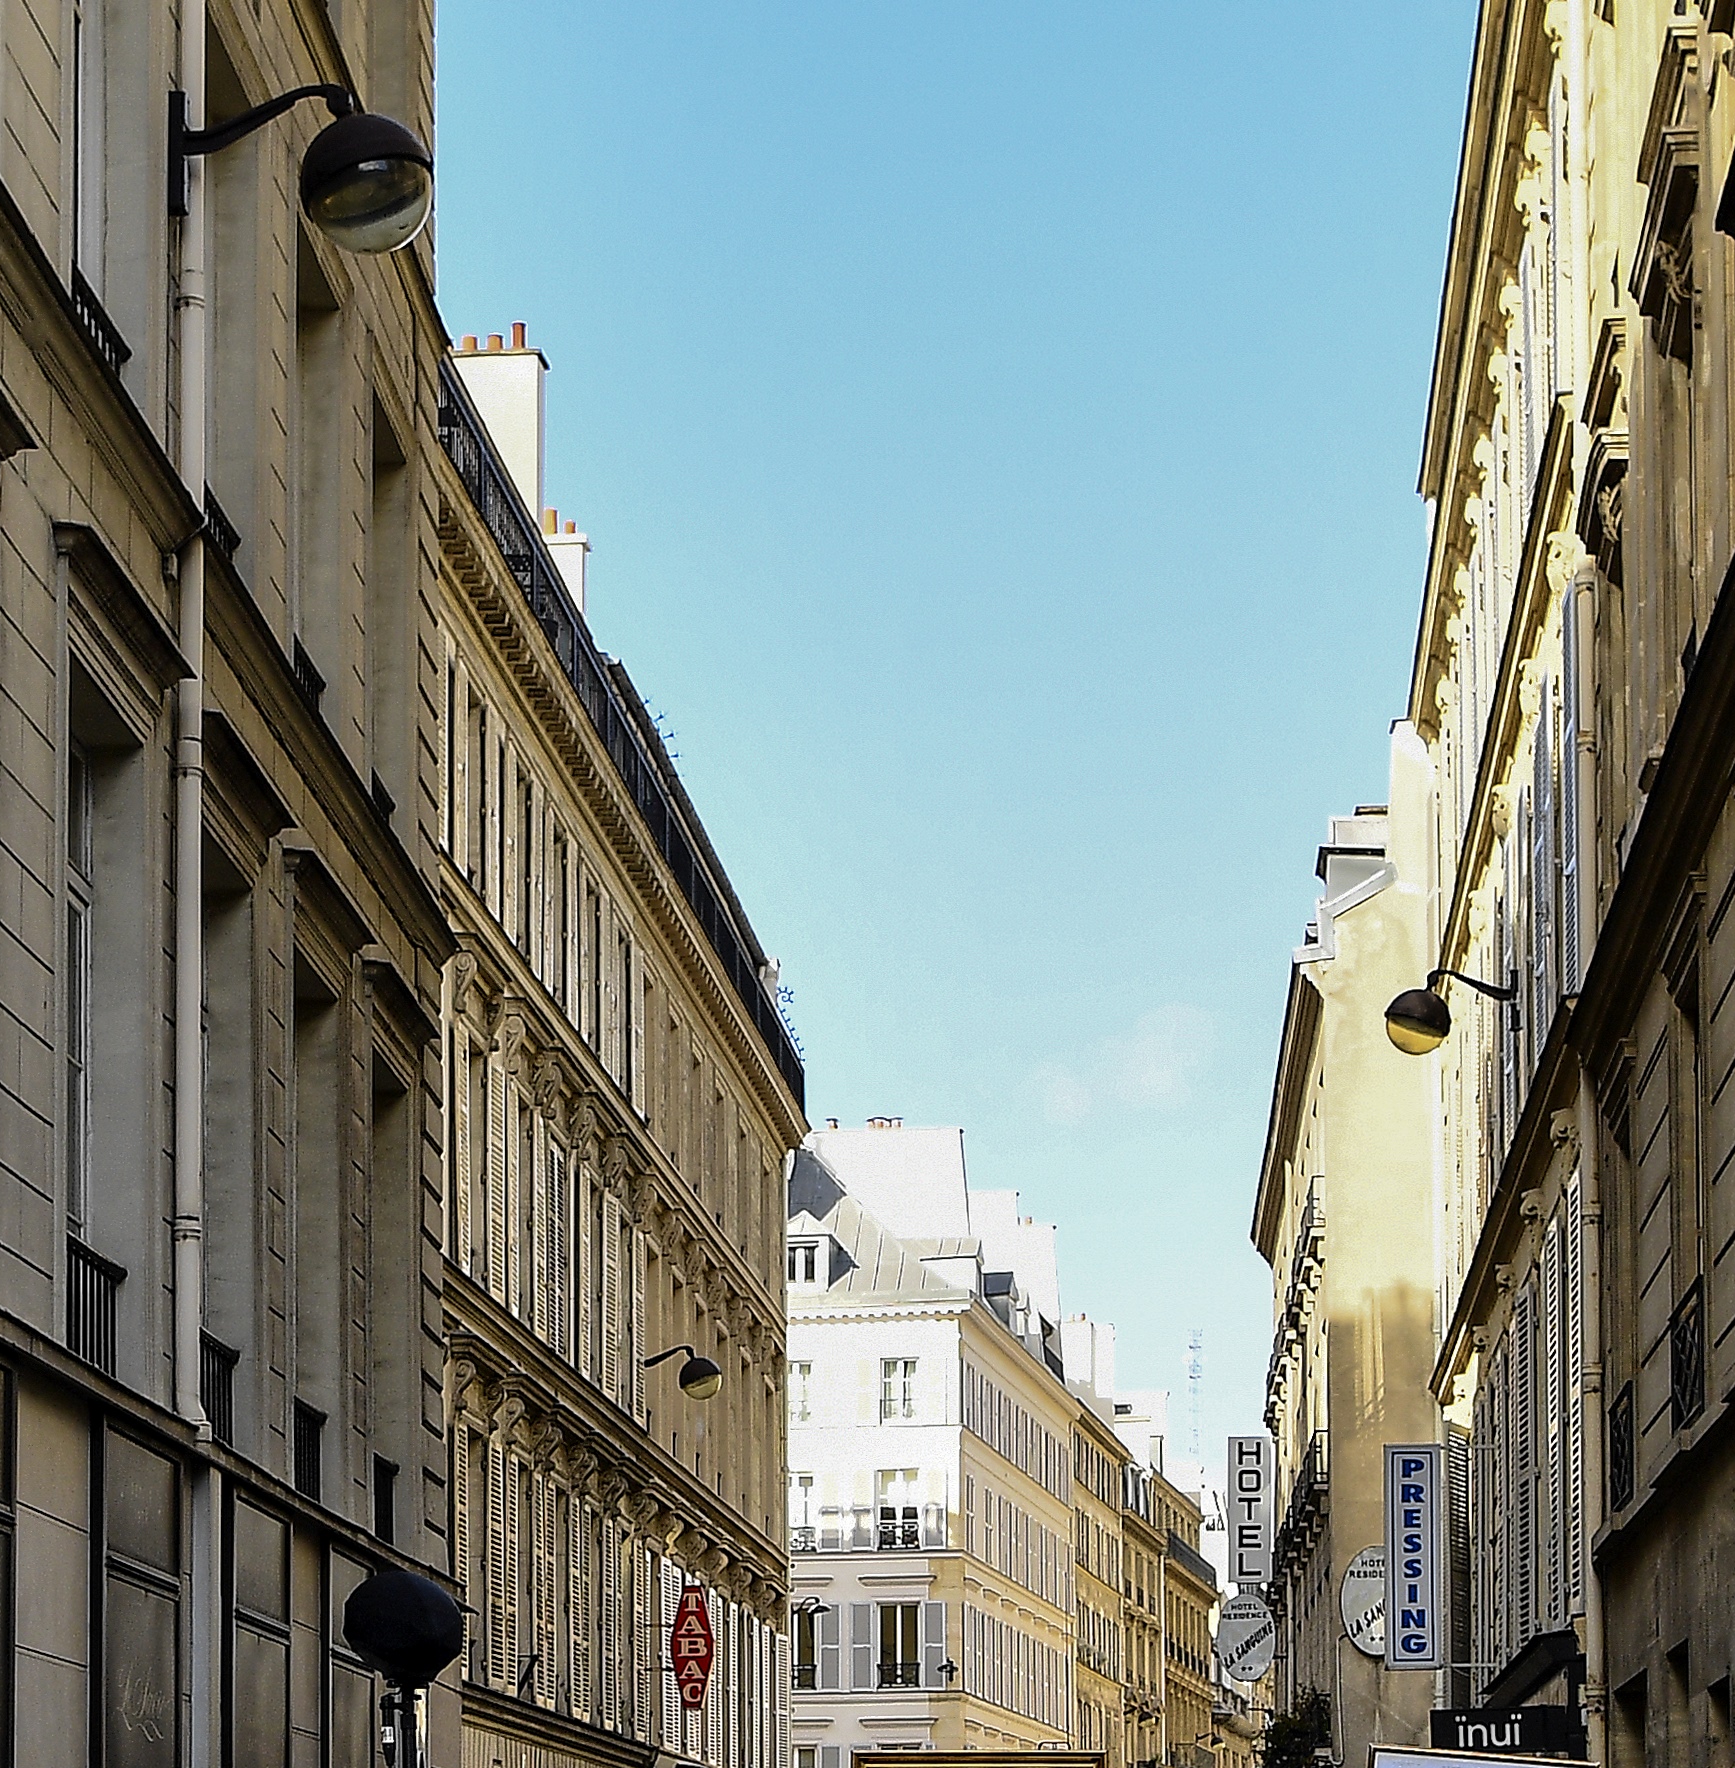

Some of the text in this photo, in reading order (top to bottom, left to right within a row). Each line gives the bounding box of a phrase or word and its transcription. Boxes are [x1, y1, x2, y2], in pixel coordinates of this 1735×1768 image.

[1237, 1440, 1263, 1577] HOTEL
[1400, 1458, 1428, 1655] PRESSING
[676, 1591, 708, 1703] TABAC
